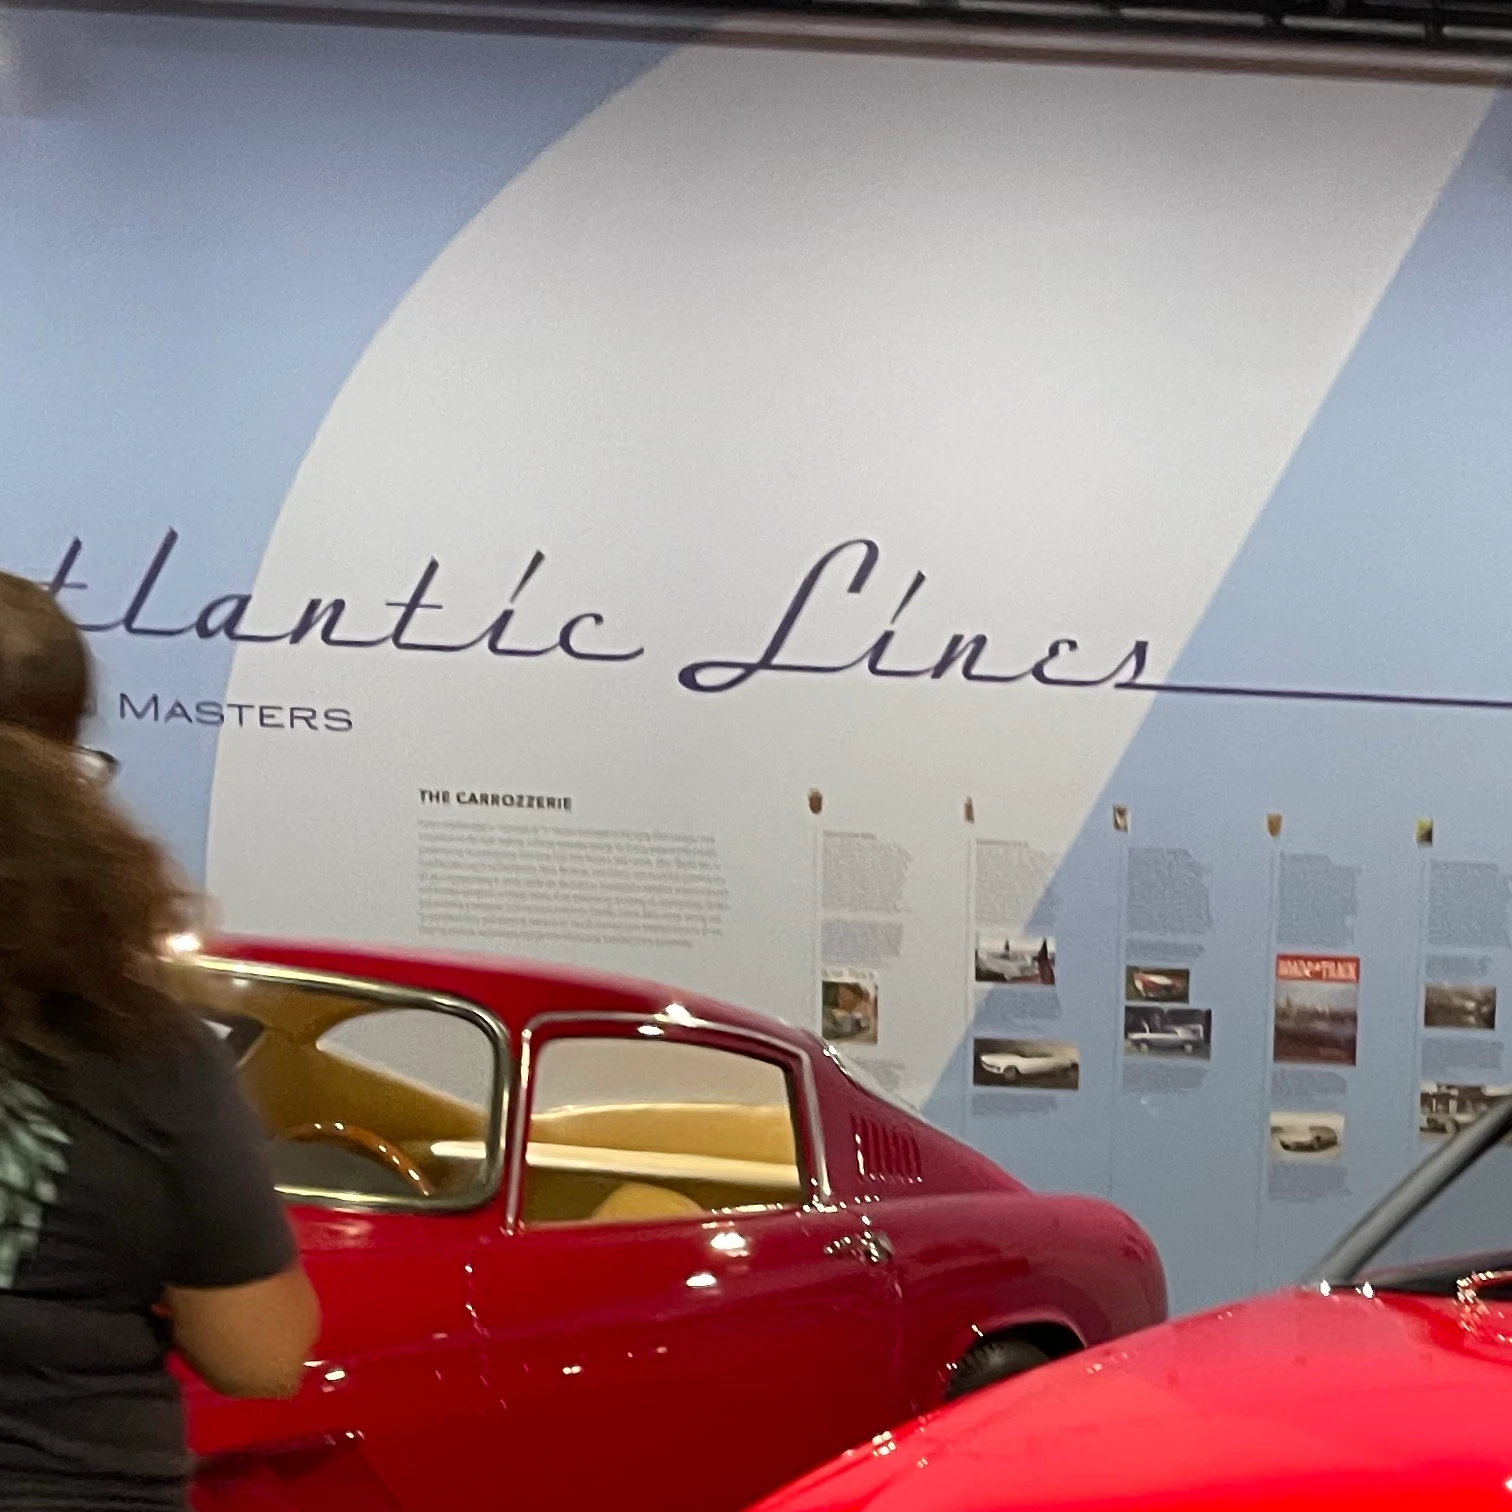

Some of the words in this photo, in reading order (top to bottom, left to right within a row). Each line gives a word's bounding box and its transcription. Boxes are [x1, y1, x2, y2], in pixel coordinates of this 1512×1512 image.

[38, 526, 644, 661] tlantic
[678, 538, 1152, 693] Lines
[119, 692, 354, 732] MASTERS
[419, 788, 450, 804] THE
[456, 791, 572, 811] CARROZZERIE
